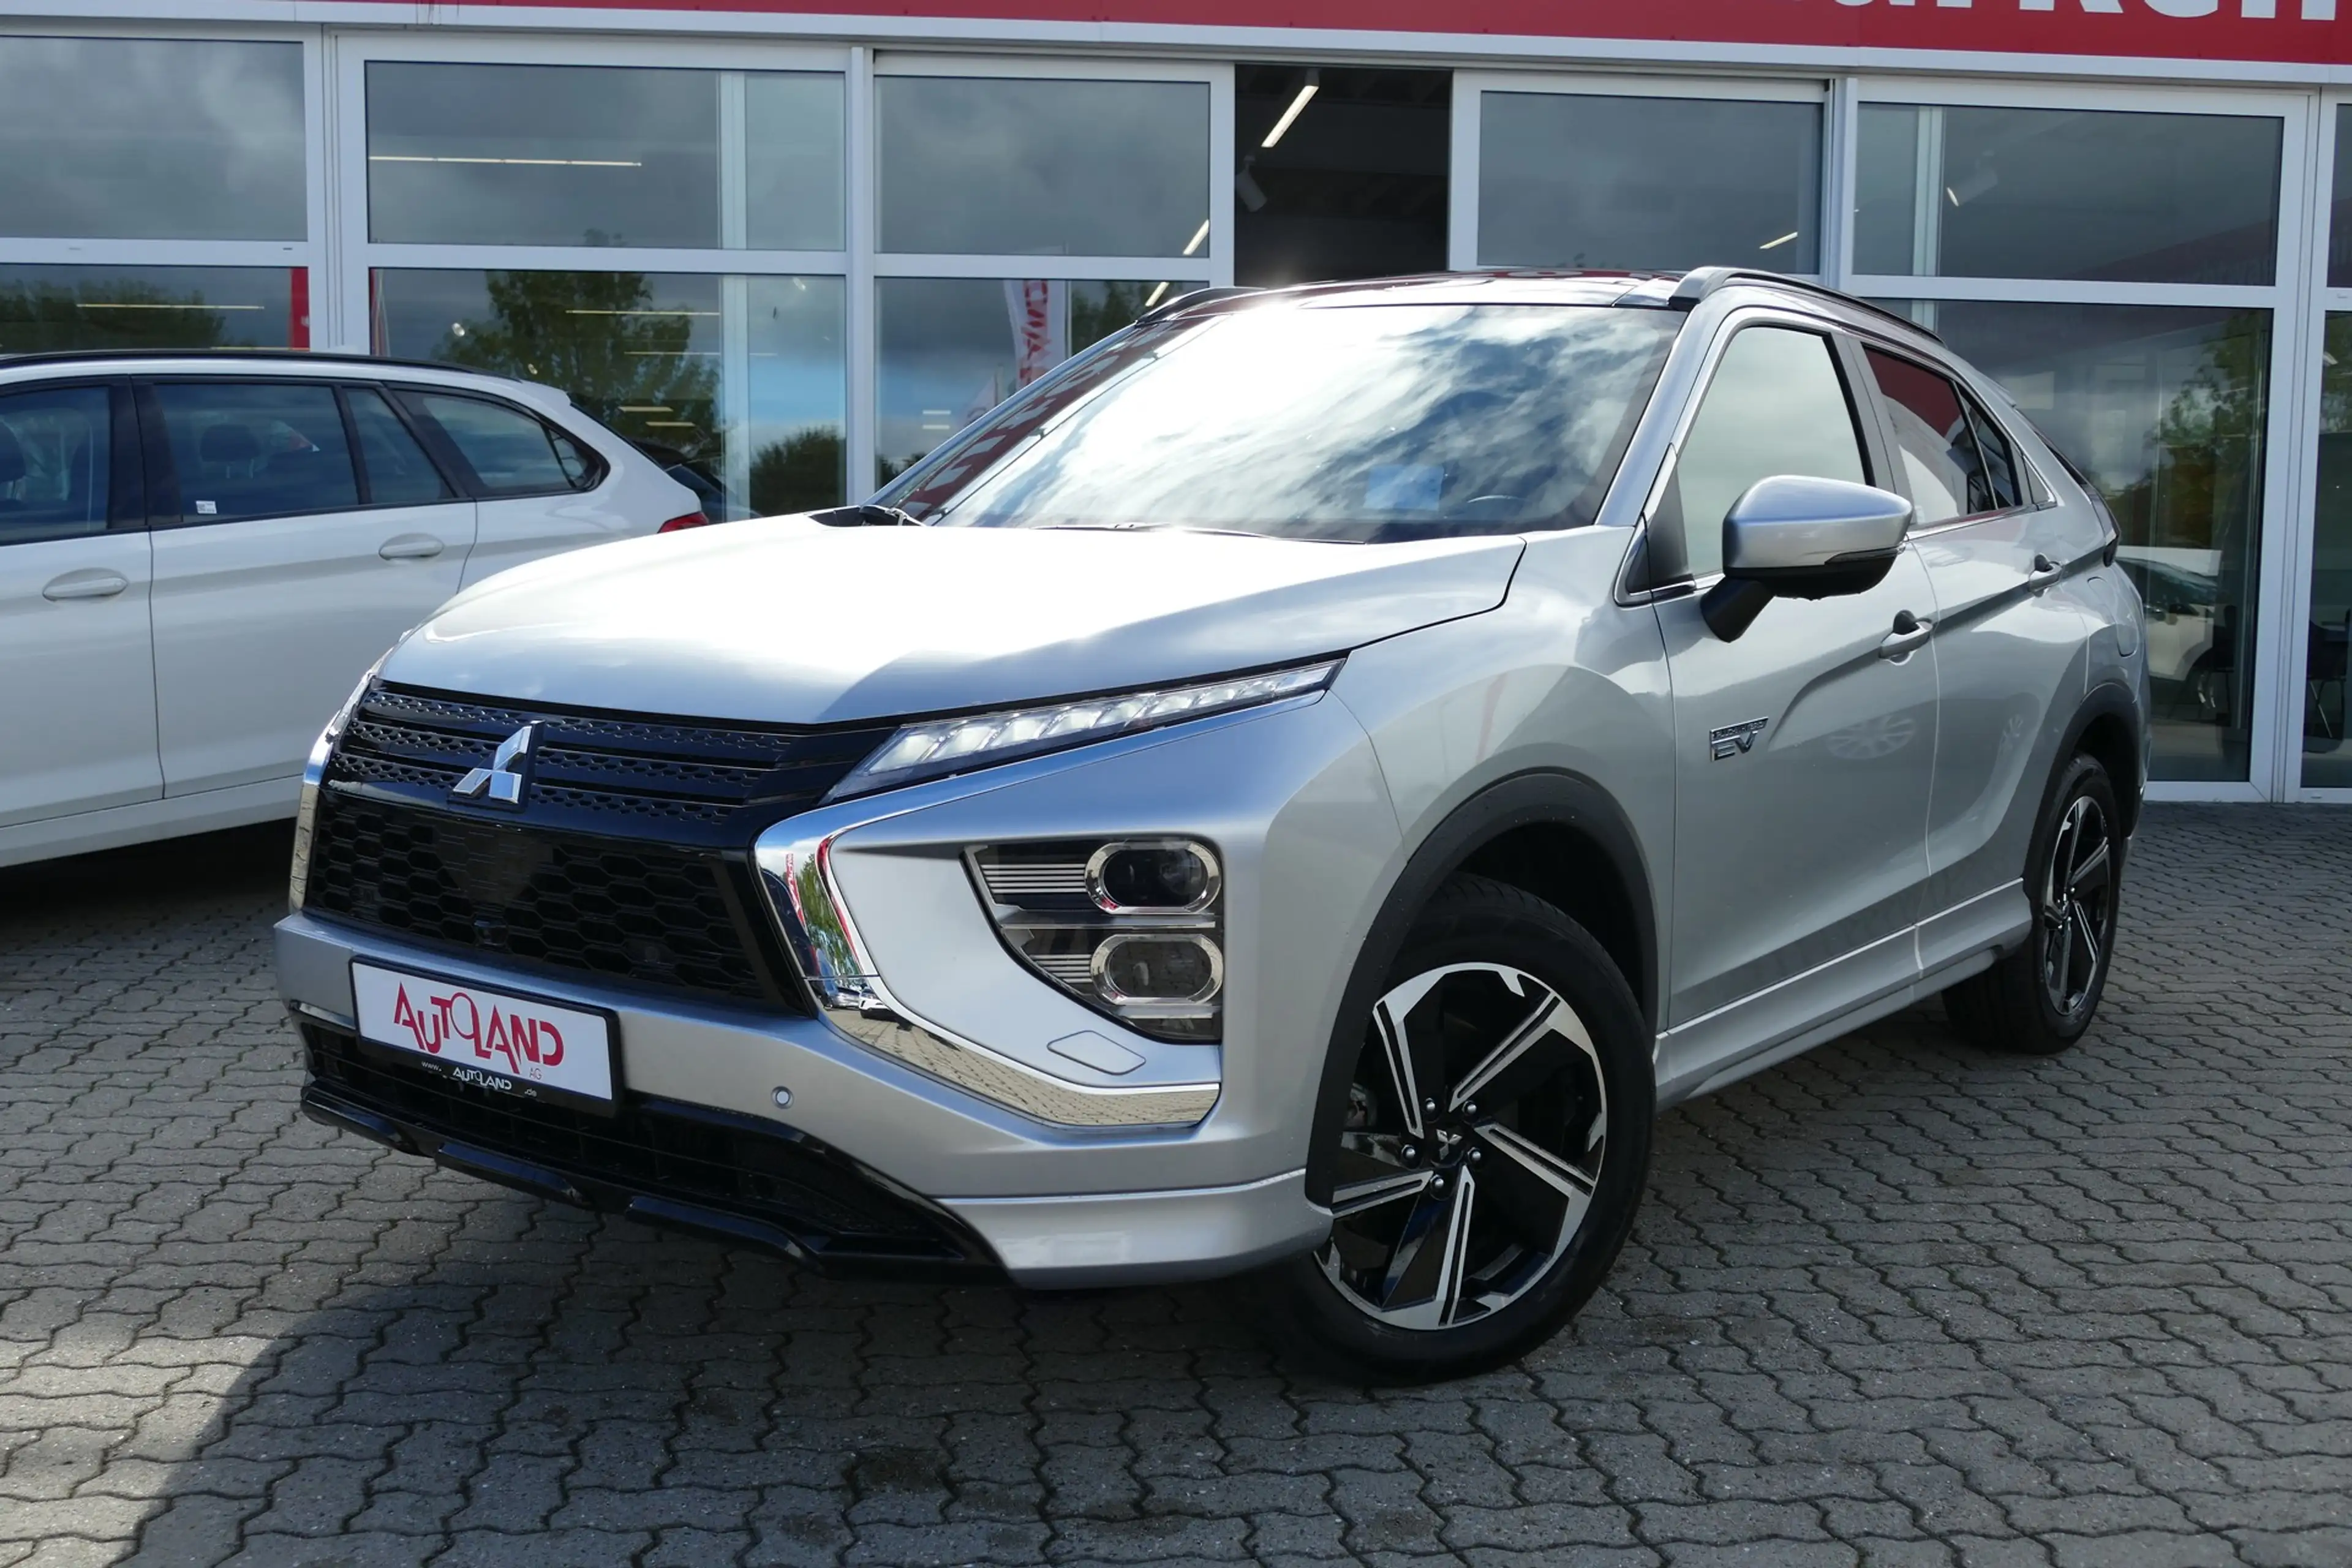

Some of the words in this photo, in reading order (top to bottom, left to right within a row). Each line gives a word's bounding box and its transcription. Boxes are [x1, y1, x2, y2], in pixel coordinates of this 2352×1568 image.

[1710, 731, 1758, 761] EV
[394, 981, 564, 1074] AUTOLAND
[453, 1067, 512, 1090] AUTOLAND
[529, 1067, 543, 1080] AG
